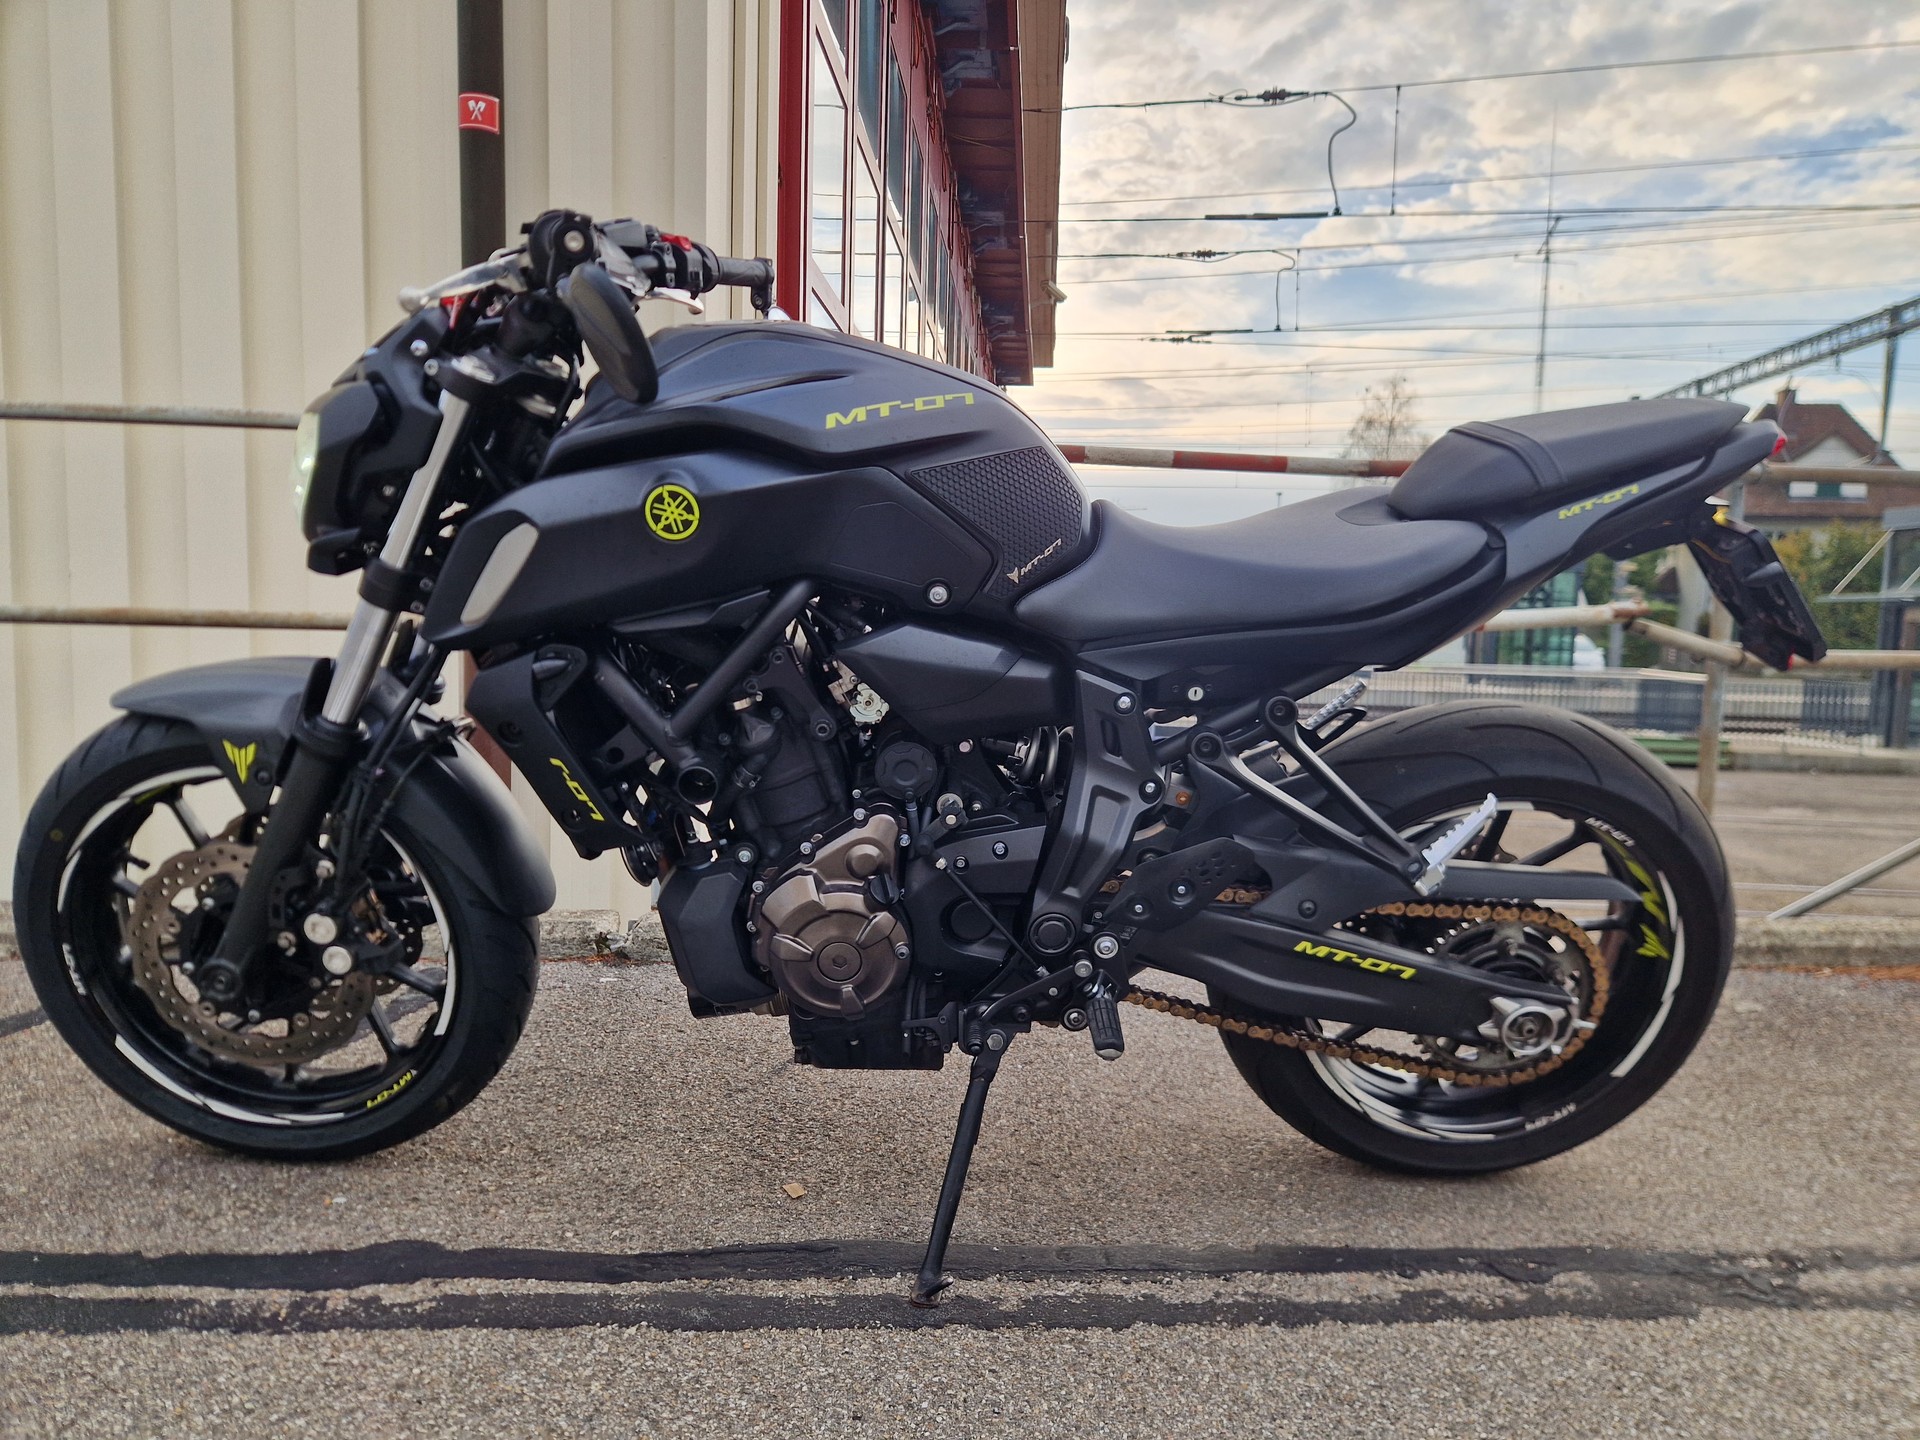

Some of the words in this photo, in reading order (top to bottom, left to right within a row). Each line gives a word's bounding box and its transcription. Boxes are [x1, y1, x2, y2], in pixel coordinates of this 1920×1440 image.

[825, 392, 974, 429] MT-07
[1558, 483, 1639, 519] MT-07
[1020, 538, 1062, 576] MT-07
[1584, 817, 1636, 847] MT-07
[1293, 940, 1417, 980] MT-07
